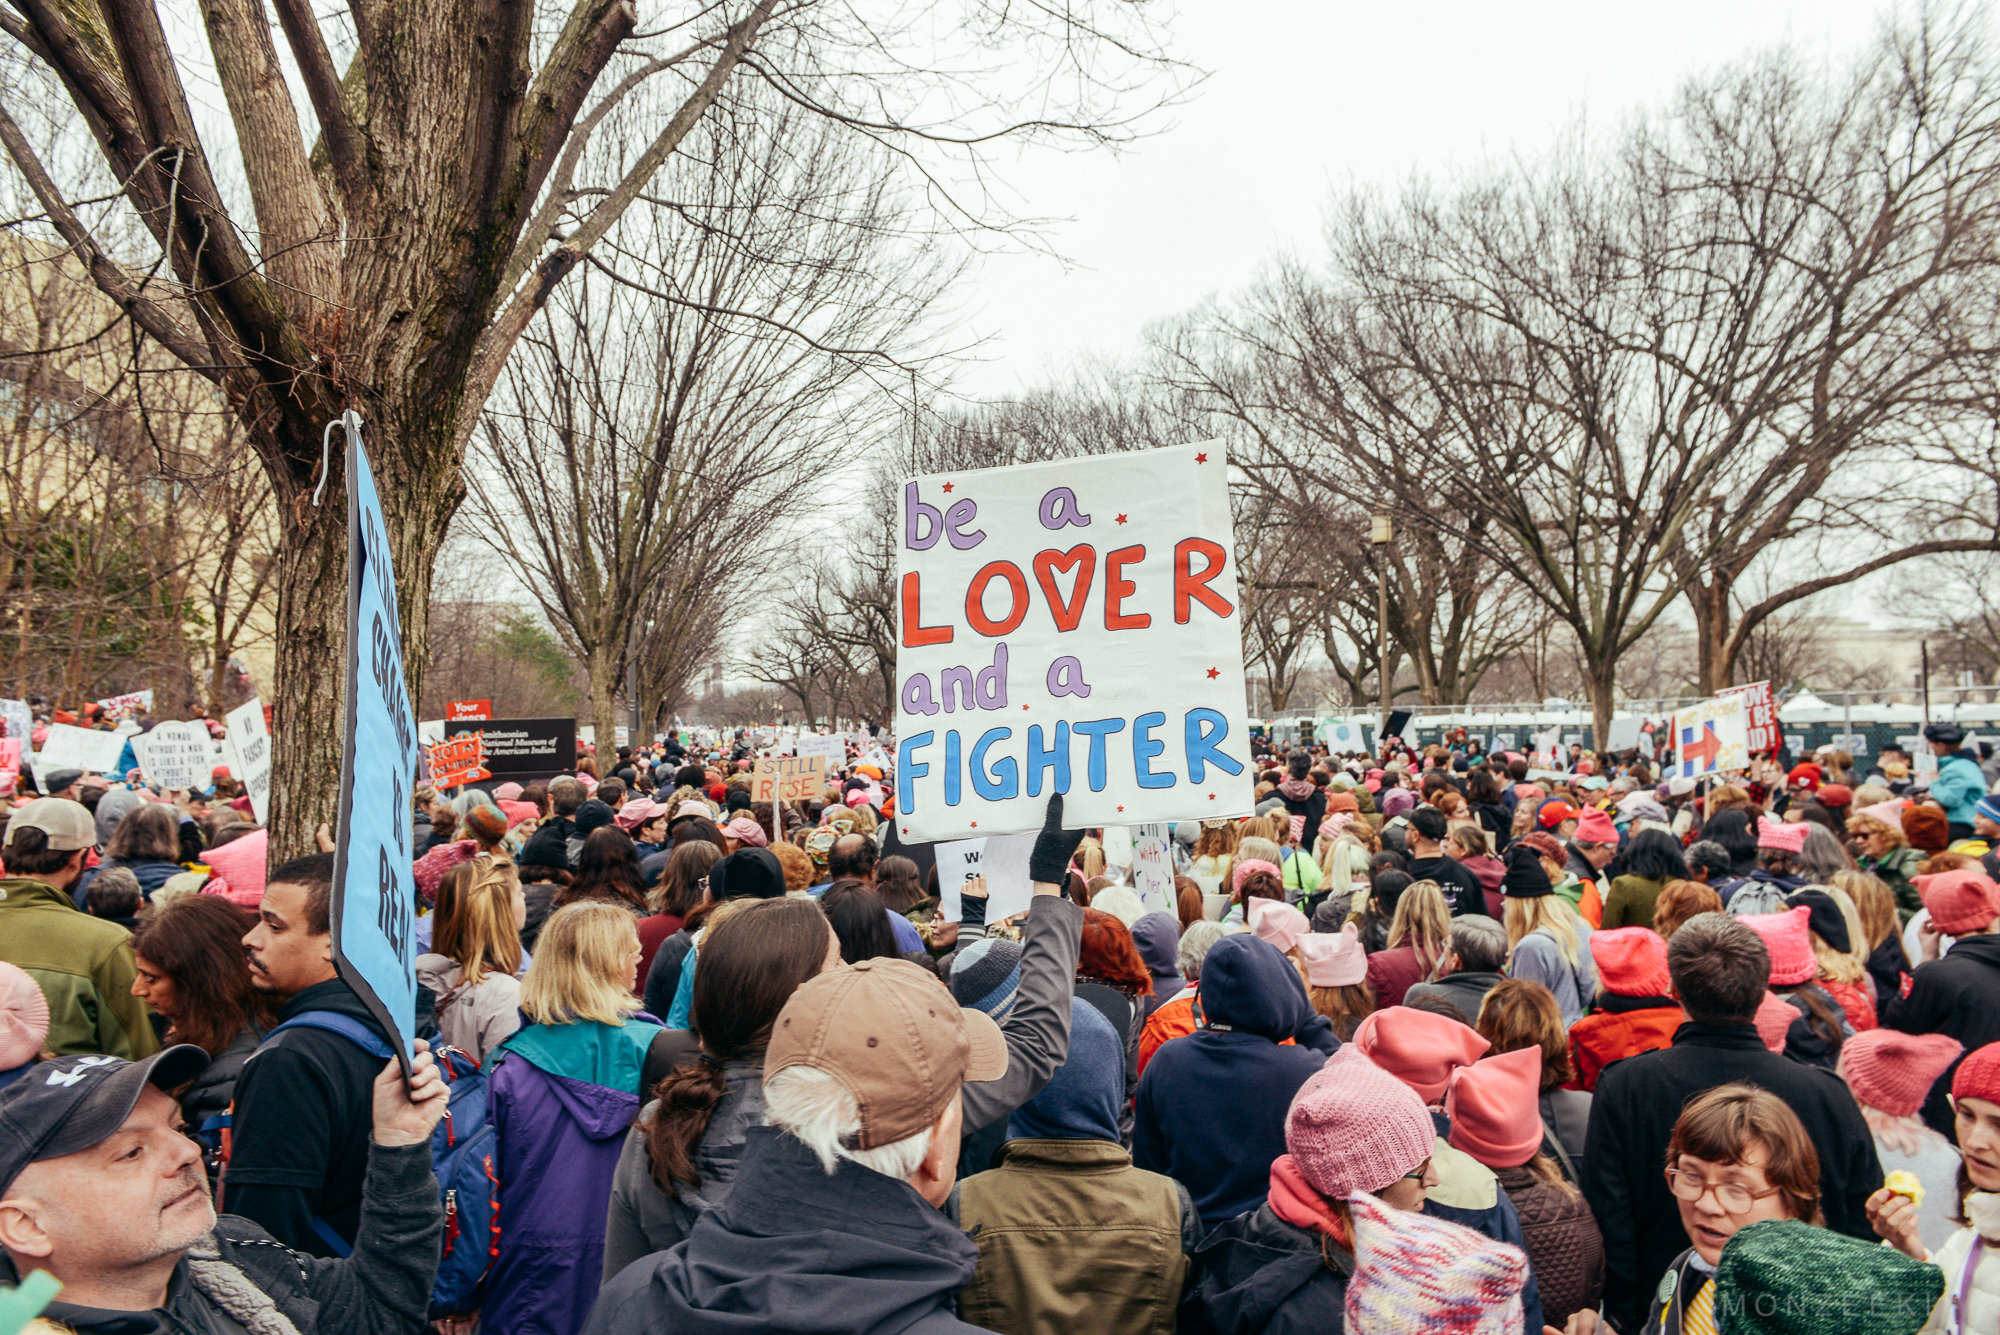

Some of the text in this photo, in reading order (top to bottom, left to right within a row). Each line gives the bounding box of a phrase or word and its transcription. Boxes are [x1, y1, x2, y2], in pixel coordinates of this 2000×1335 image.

[905, 481, 1091, 551] be a
[901, 537, 1235, 648] LOVER
[902, 642, 1091, 716] and a
[1744, 685, 1770, 707] OVE
[454, 702, 479, 712] Your
[451, 712, 487, 721] silence
[167, 732, 191, 741] WOMAN
[548, 737, 558, 747] of
[1748, 725, 1776, 751] UD!
[148, 745, 176, 754] WITHOUT
[188, 744, 203, 752] MAN
[493, 748, 530, 756] American
[531, 746, 556, 755] Indian
[188, 756, 205, 765] FISH
[762, 757, 817, 775] STILL
[899, 707, 1244, 815] FIGHTER
[153, 769, 183, 777] WITHOUT
[964, 851, 983, 864] W
[1139, 842, 1161, 864] with
[1145, 872, 1161, 894] her
[379, 843, 411, 994] REAL
